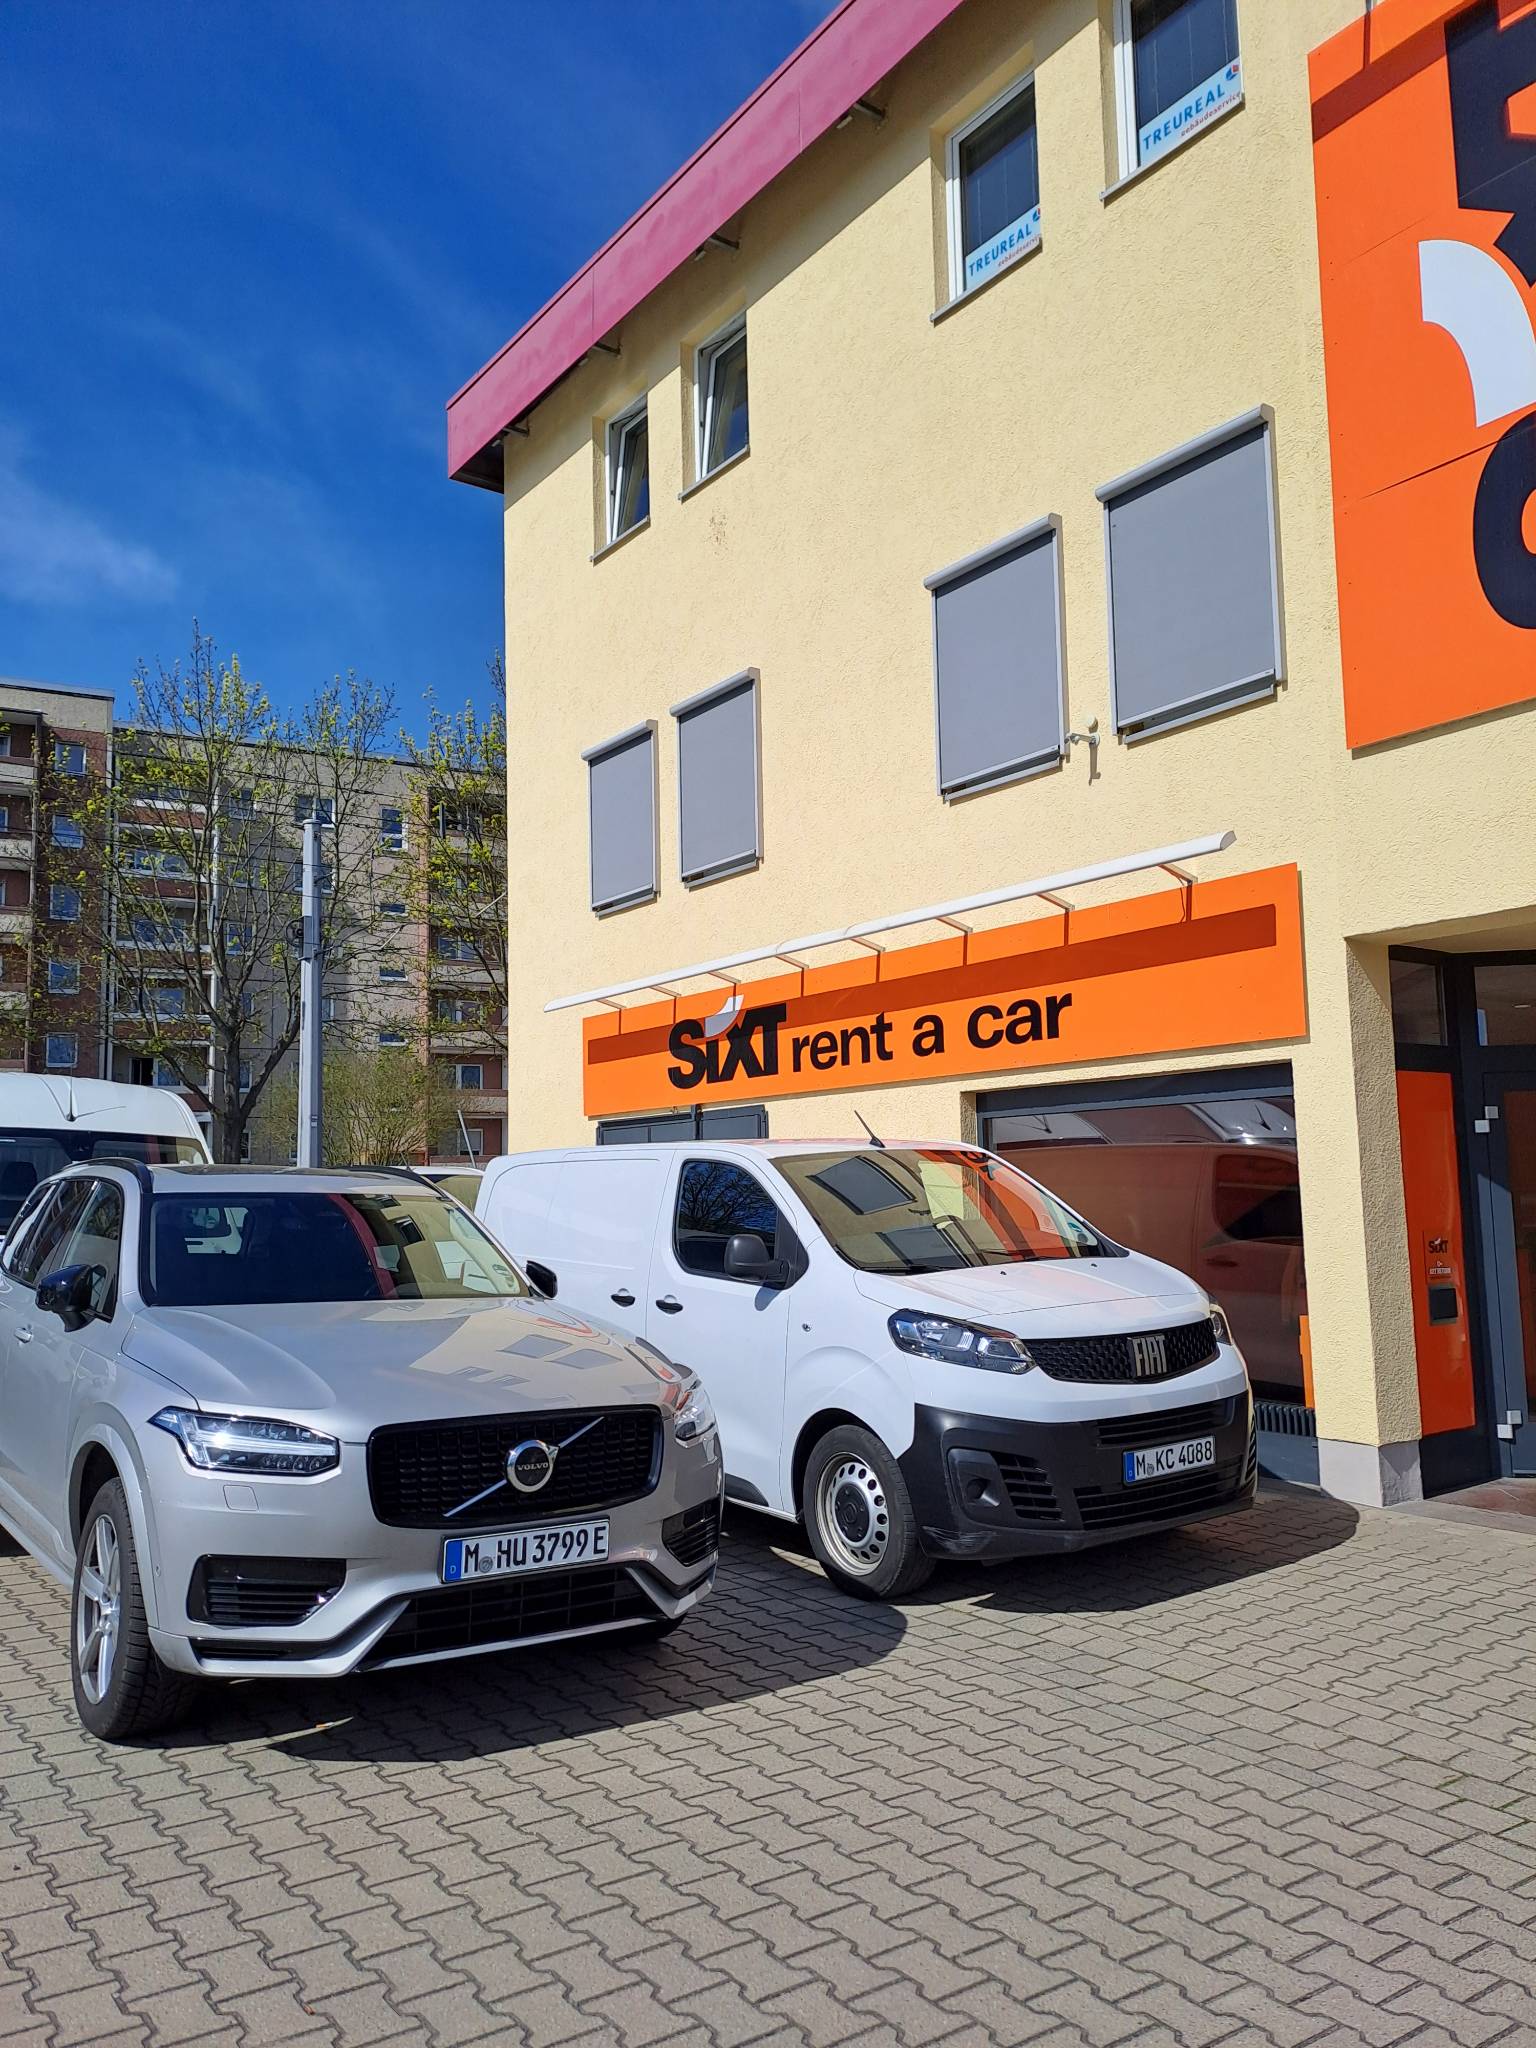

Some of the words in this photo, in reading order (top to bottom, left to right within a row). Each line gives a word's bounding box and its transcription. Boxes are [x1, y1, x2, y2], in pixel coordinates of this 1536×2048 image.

[1143, 83, 1225, 150] TREUREAL
[969, 223, 1032, 277] TREUREAL
[793, 1011, 893, 1072] rent
[912, 1014, 945, 1057] a
[967, 993, 1072, 1049] car
[1132, 1335, 1167, 1376] FIAT
[517, 1462, 549, 1471] VOLVO
[1136, 1453, 1146, 1477] M
[1156, 1448, 1175, 1473] KC
[1178, 1440, 1212, 1466] 4088
[463, 1542, 480, 1574] M
[496, 1536, 527, 1569] HU
